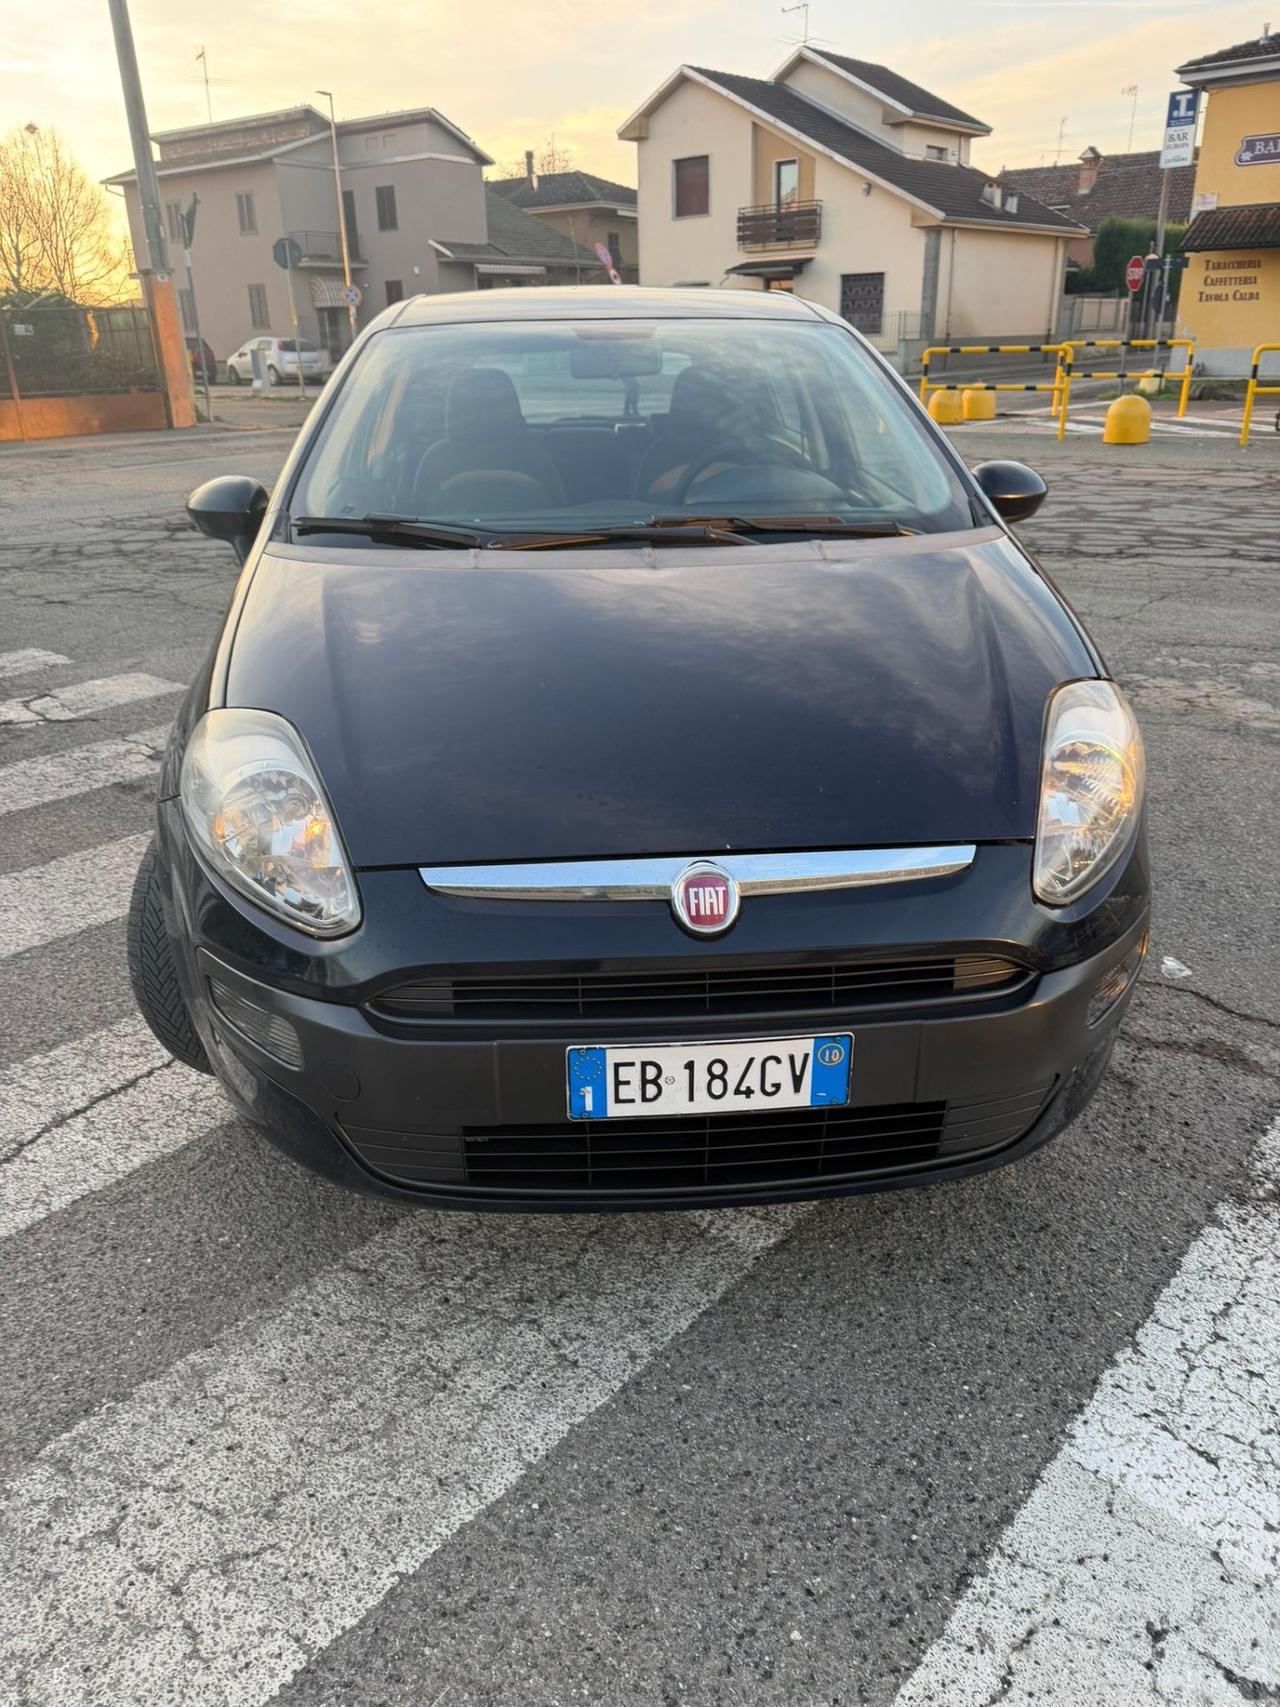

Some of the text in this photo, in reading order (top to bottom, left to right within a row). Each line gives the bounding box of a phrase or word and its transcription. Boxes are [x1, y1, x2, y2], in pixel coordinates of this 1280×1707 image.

[1168, 132, 1189, 143] BAR
[1125, 267, 1144, 281] STOP
[688, 886, 726, 917] FIAT
[823, 1050, 840, 1062] 10
[613, 1052, 811, 1105] EB 184GV
